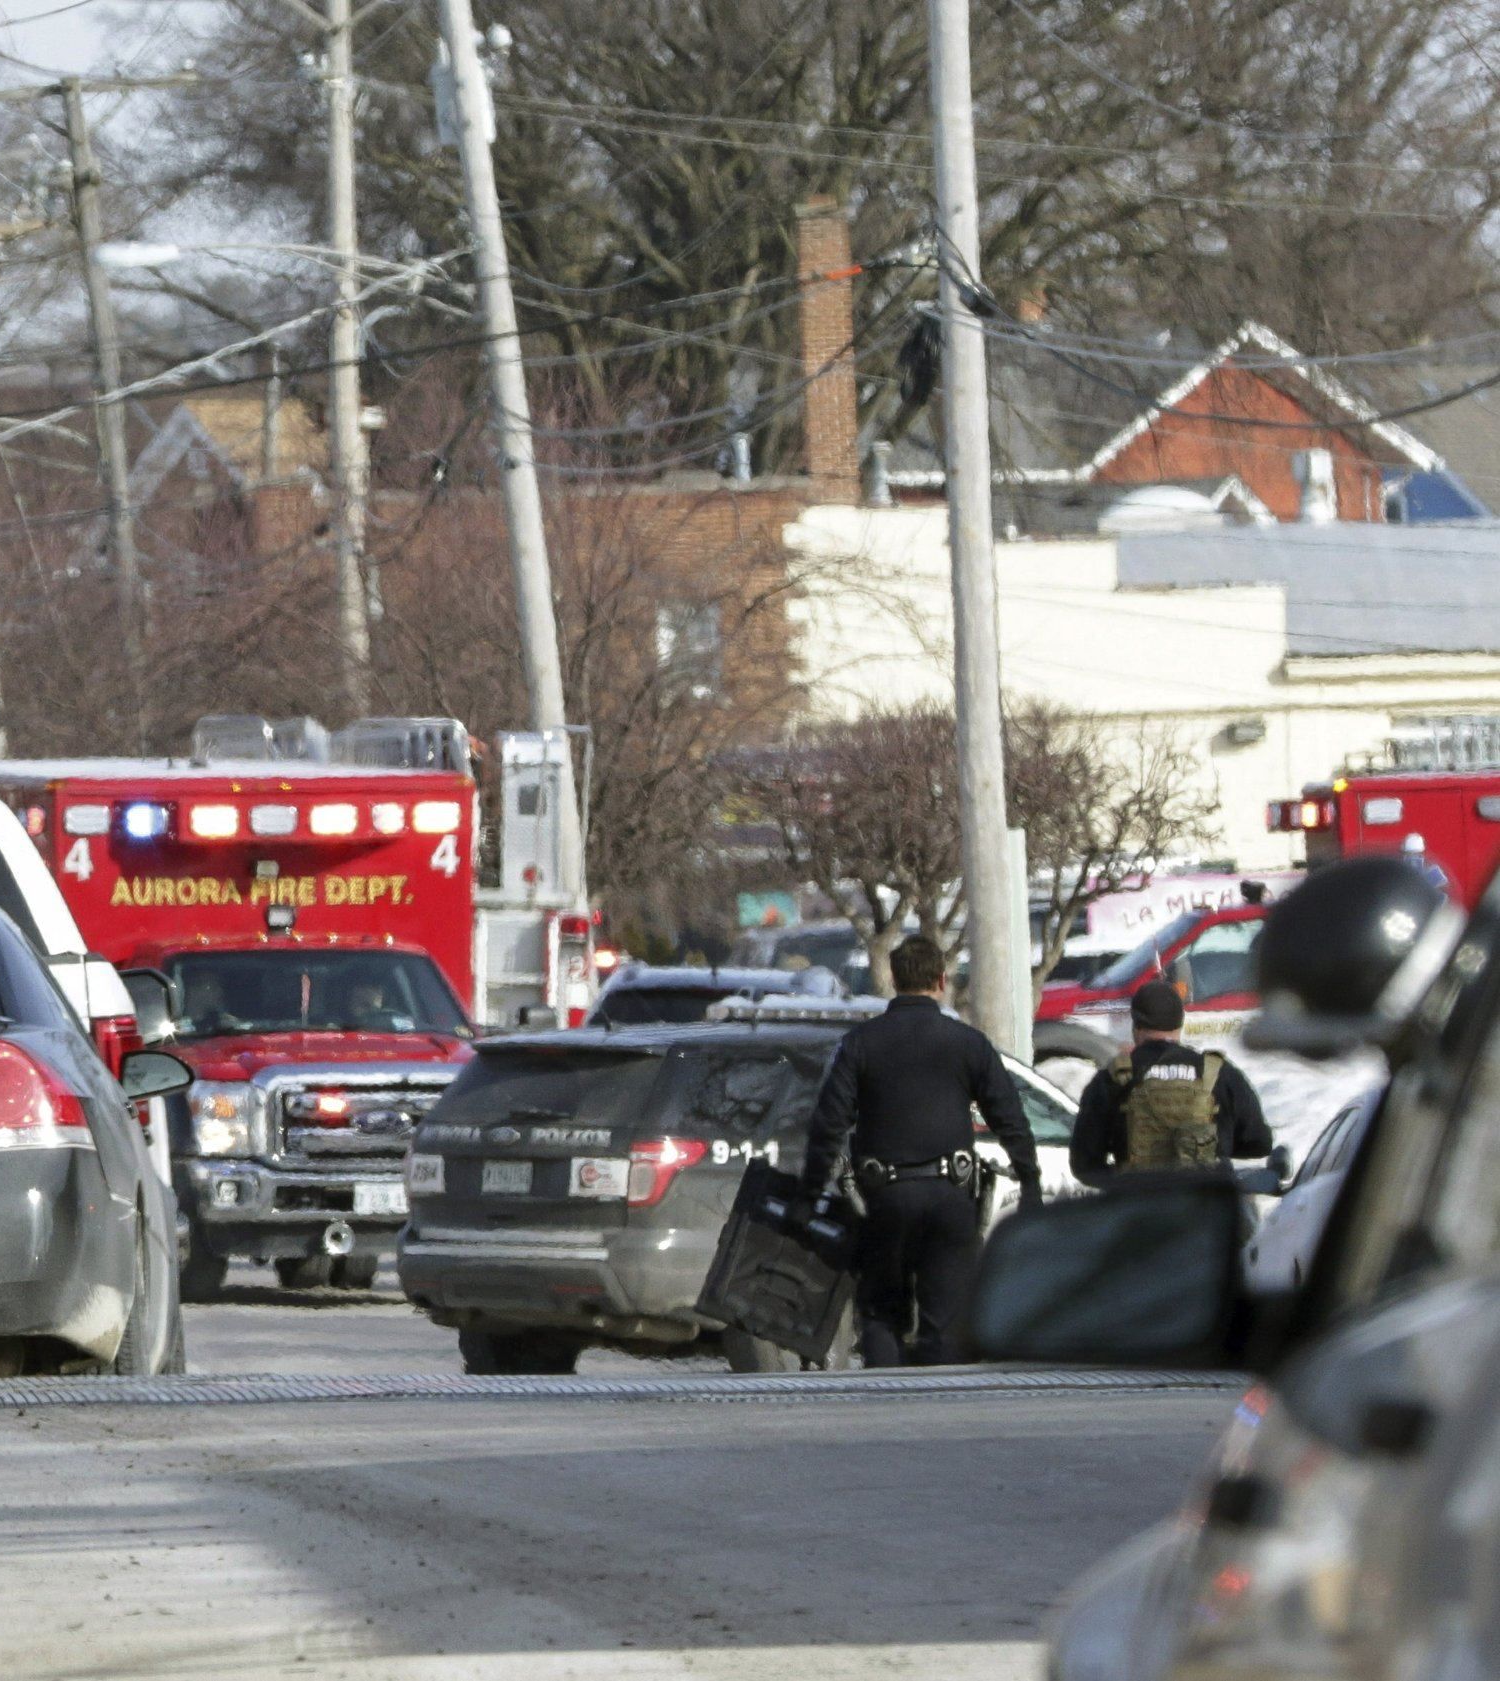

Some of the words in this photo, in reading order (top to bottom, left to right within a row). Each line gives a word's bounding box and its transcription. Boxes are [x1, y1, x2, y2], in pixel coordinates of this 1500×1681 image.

[65, 837, 93, 882] 4
[430, 834, 460, 878] 4
[111, 875, 243, 905] AURORA
[251, 875, 317, 906] FIRE
[324, 875, 415, 906] DEPT.
[1123, 906, 1154, 929] LA
[712, 1139, 779, 1168] 9-1-1
